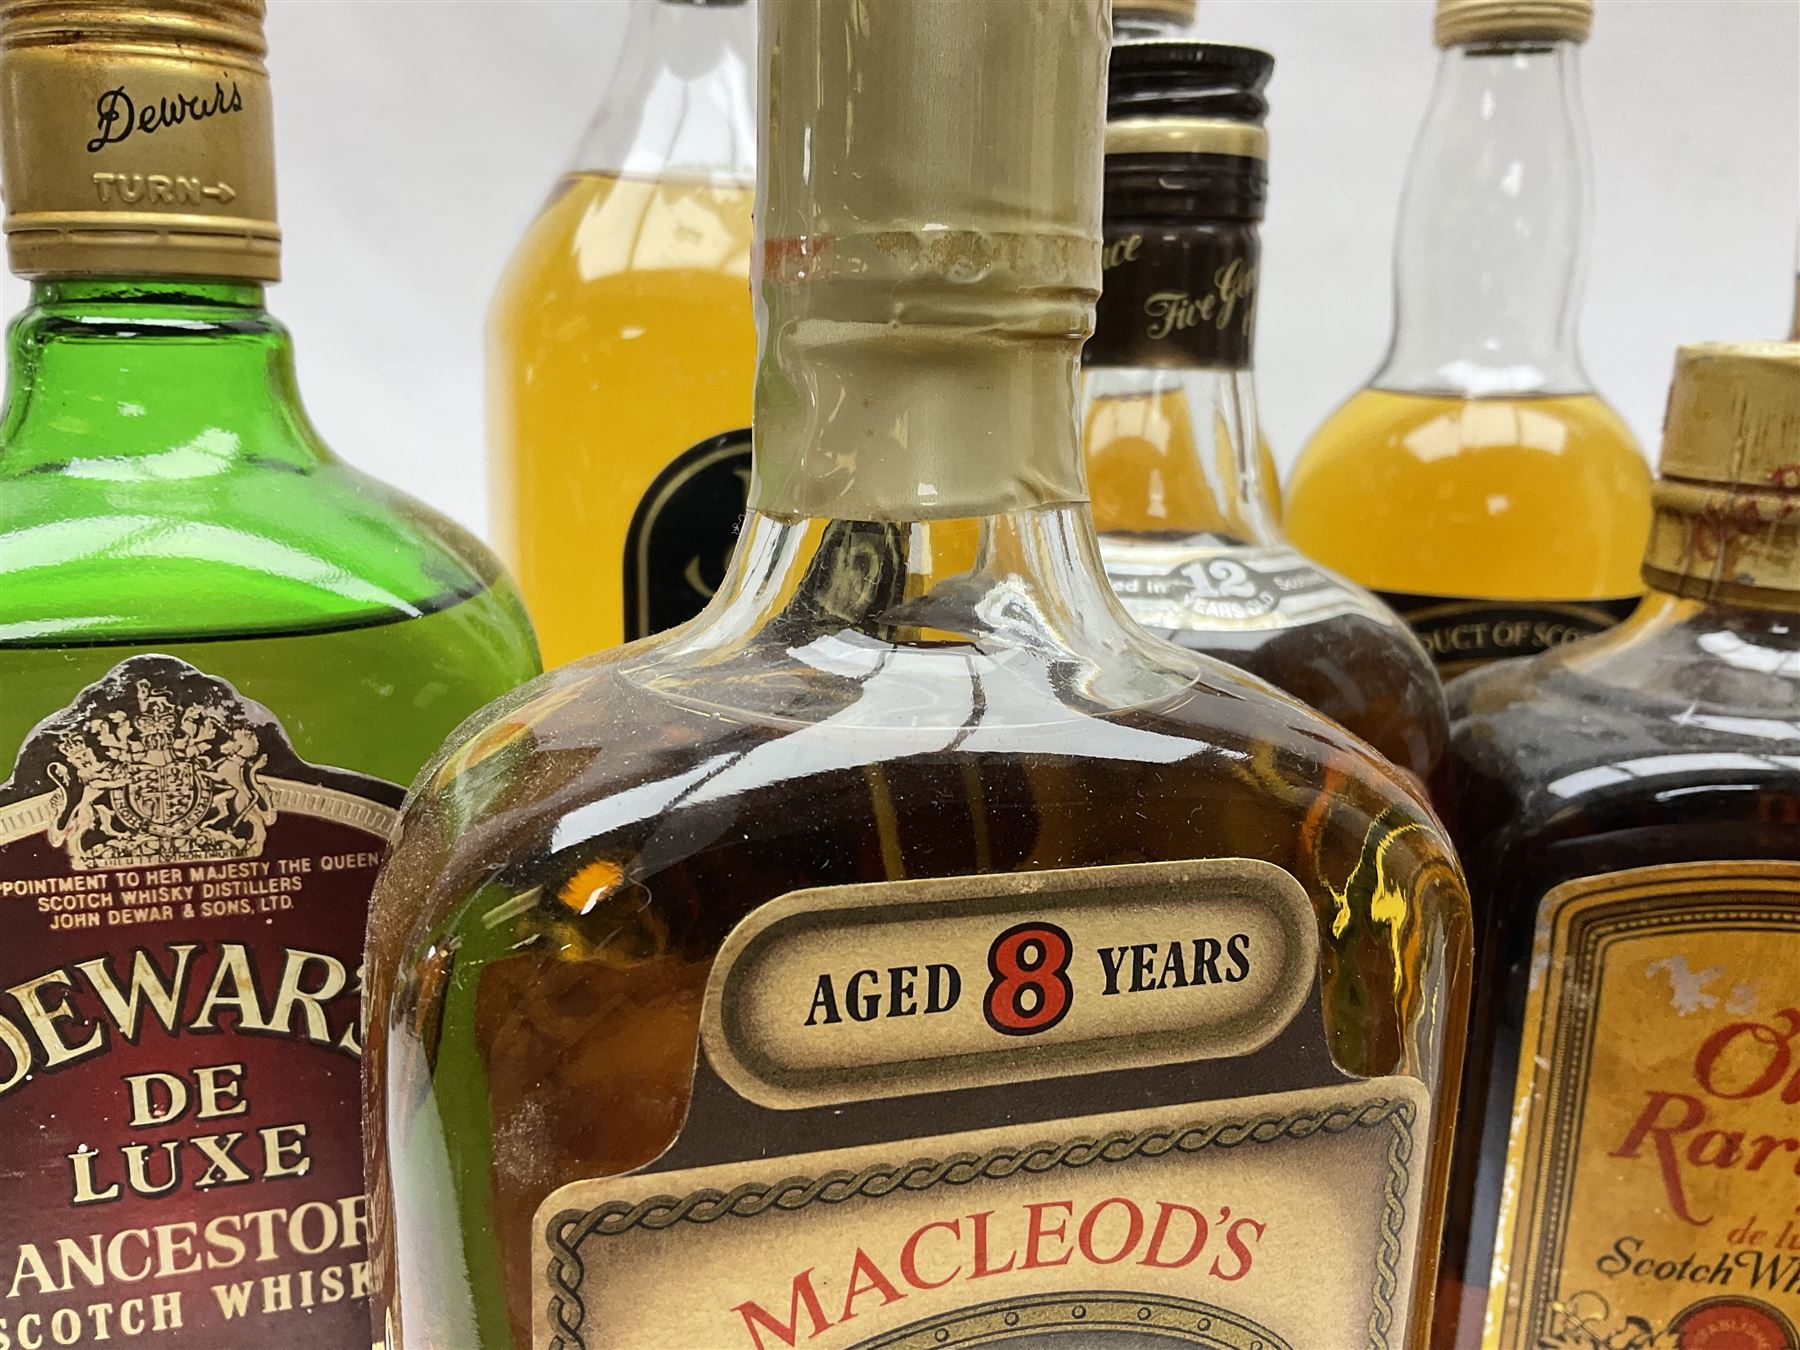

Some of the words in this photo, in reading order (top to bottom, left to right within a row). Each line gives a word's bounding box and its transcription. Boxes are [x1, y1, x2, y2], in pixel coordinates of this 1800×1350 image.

[87, 72, 242, 153] Dewar's
[93, 172, 201, 207] TURN
[1144, 291, 1216, 339] Five
[1147, 579, 1168, 594] in
[1181, 558, 1256, 598] 12
[38, 892, 113, 912] SCOTCH
[121, 886, 194, 905] WHISKY
[203, 876, 303, 898] DISTILLERS
[116, 871, 140, 888] TO
[146, 867, 183, 886] HER
[190, 861, 270, 882] MAJESTY
[278, 858, 312, 874] THE
[321, 852, 379, 871] QUEEN
[50, 912, 101, 930] JOHN
[108, 906, 174, 925] DEWAR
[183, 903, 195, 919] &
[804, 963, 963, 1027] AGED
[982, 921, 1074, 1037] 8
[1097, 934, 1251, 997] YEARS
[125, 1063, 247, 1127] DE
[68, 1124, 311, 1203] LUXE
[1607, 1090, 1800, 1227] Rar
[1727, 1215, 1769, 1246] de
[730, 1196, 1267, 1350] MACLEOD'S
[1596, 1236, 1733, 1286] Scotch
